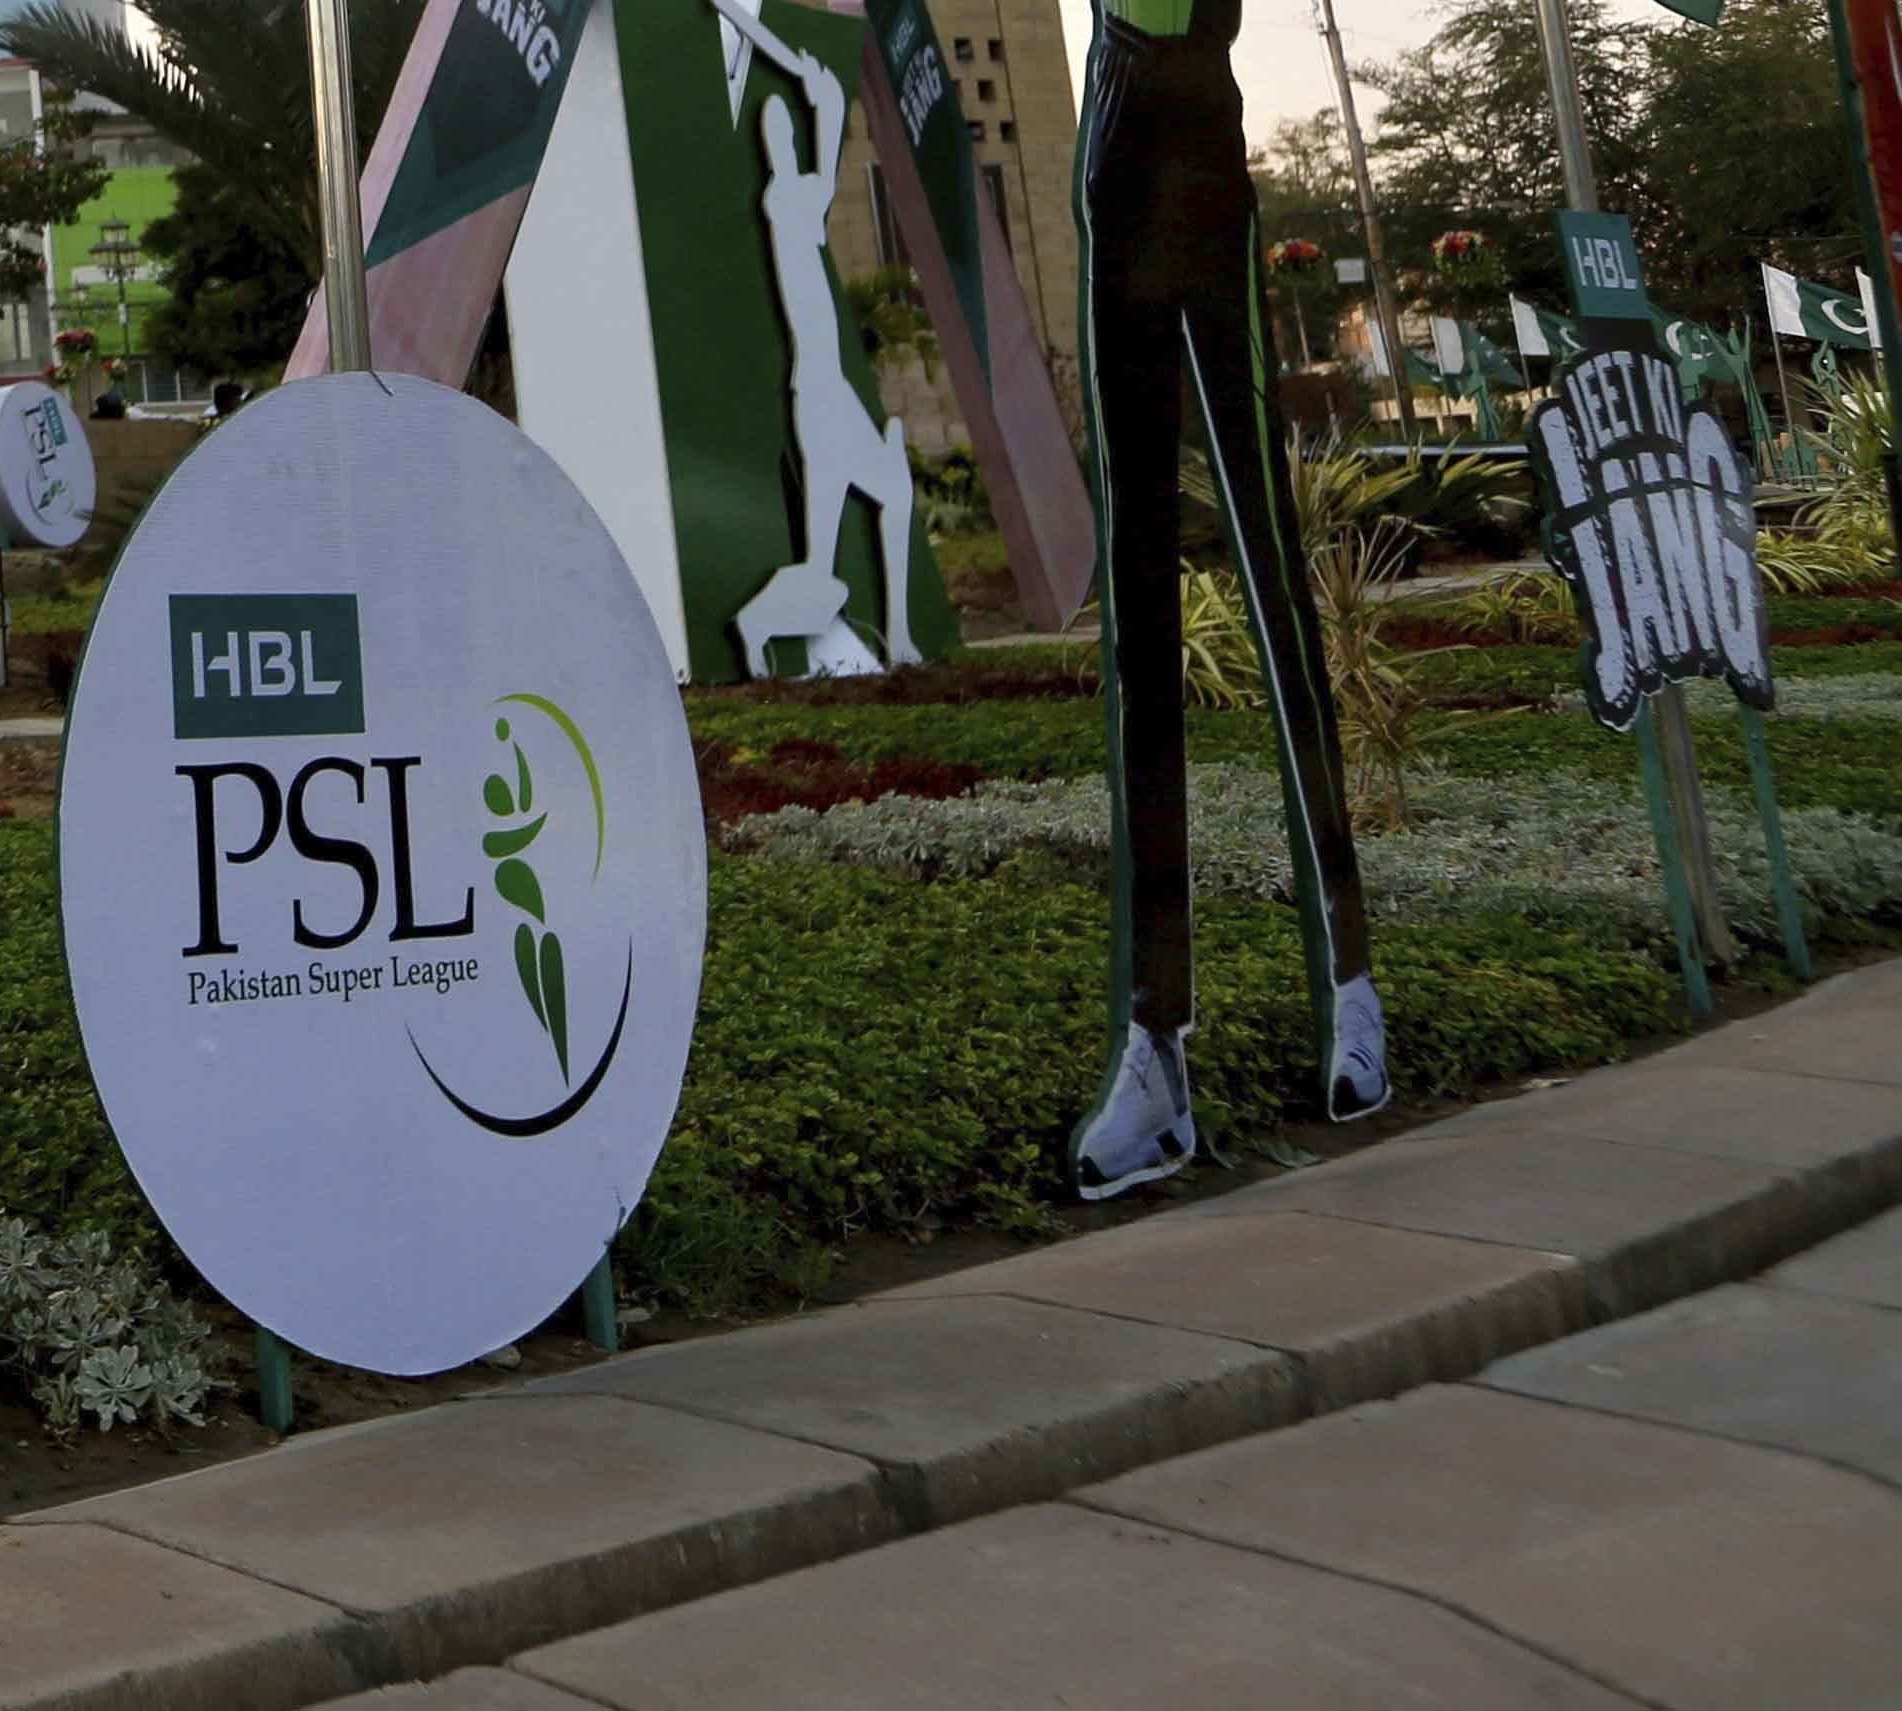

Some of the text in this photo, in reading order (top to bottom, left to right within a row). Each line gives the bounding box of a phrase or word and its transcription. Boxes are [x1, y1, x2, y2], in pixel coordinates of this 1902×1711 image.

[1572, 237, 1637, 289] HBL
[1565, 351, 1684, 459] JEET KI
[1538, 405, 1768, 705] JANG
[191, 630, 343, 698] HBL
[174, 756, 476, 959] PSL
[187, 954, 479, 1005] Pakistan Super League
